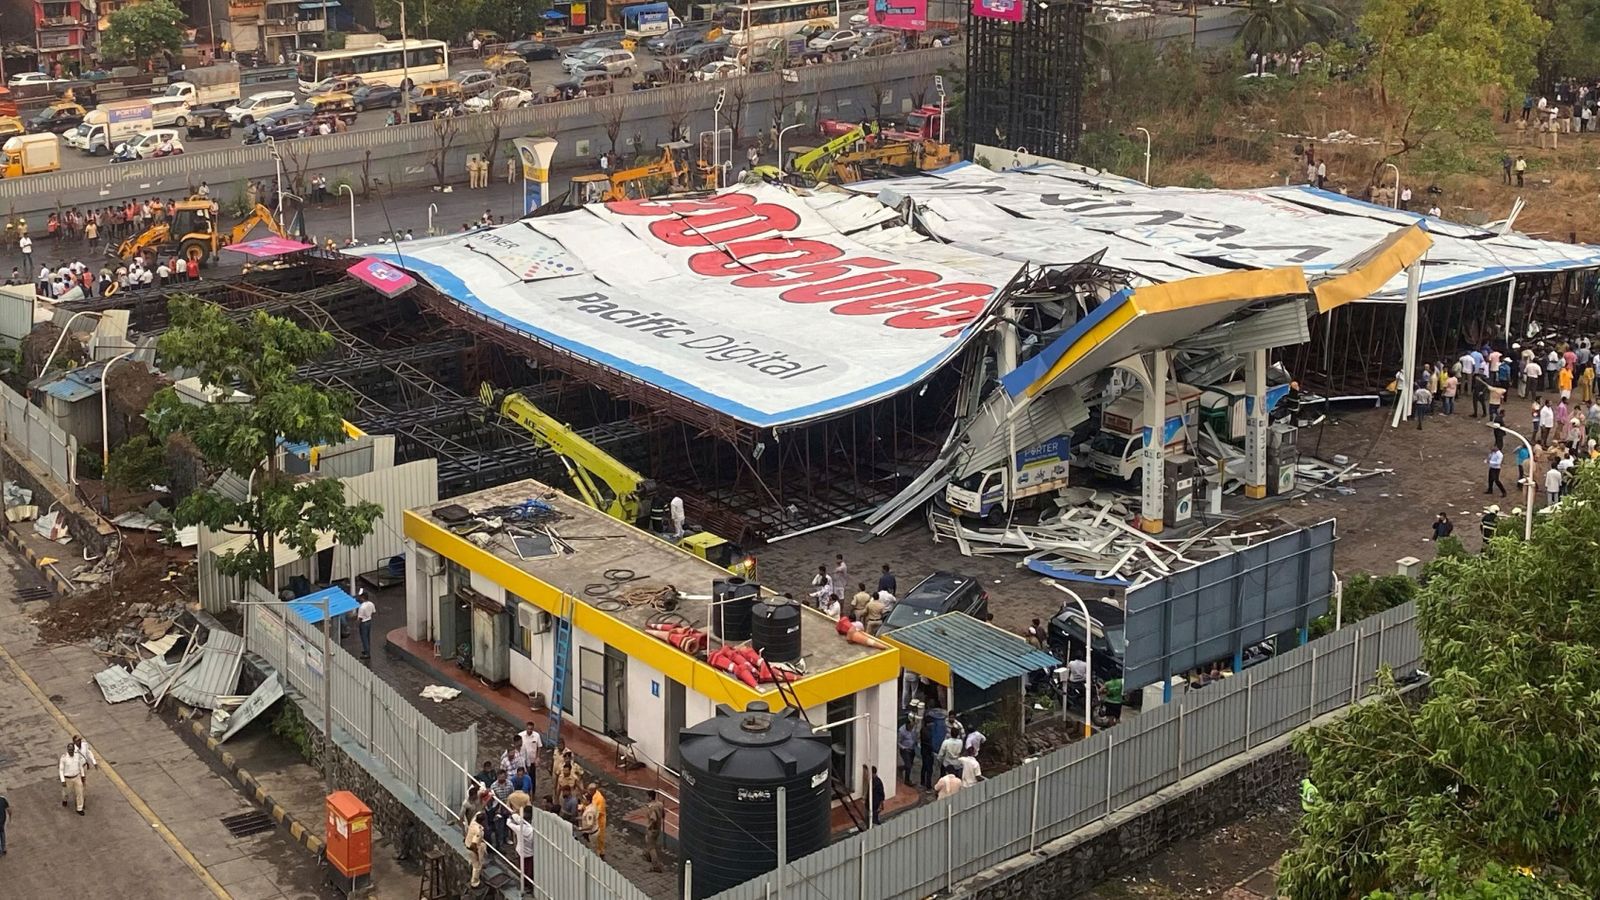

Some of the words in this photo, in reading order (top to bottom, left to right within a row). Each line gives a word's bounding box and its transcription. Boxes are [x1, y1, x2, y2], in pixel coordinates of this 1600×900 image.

[558, 292, 695, 339] Pacific
[679, 334, 828, 380] Digital
[1024, 442, 1059, 457] PORTER
